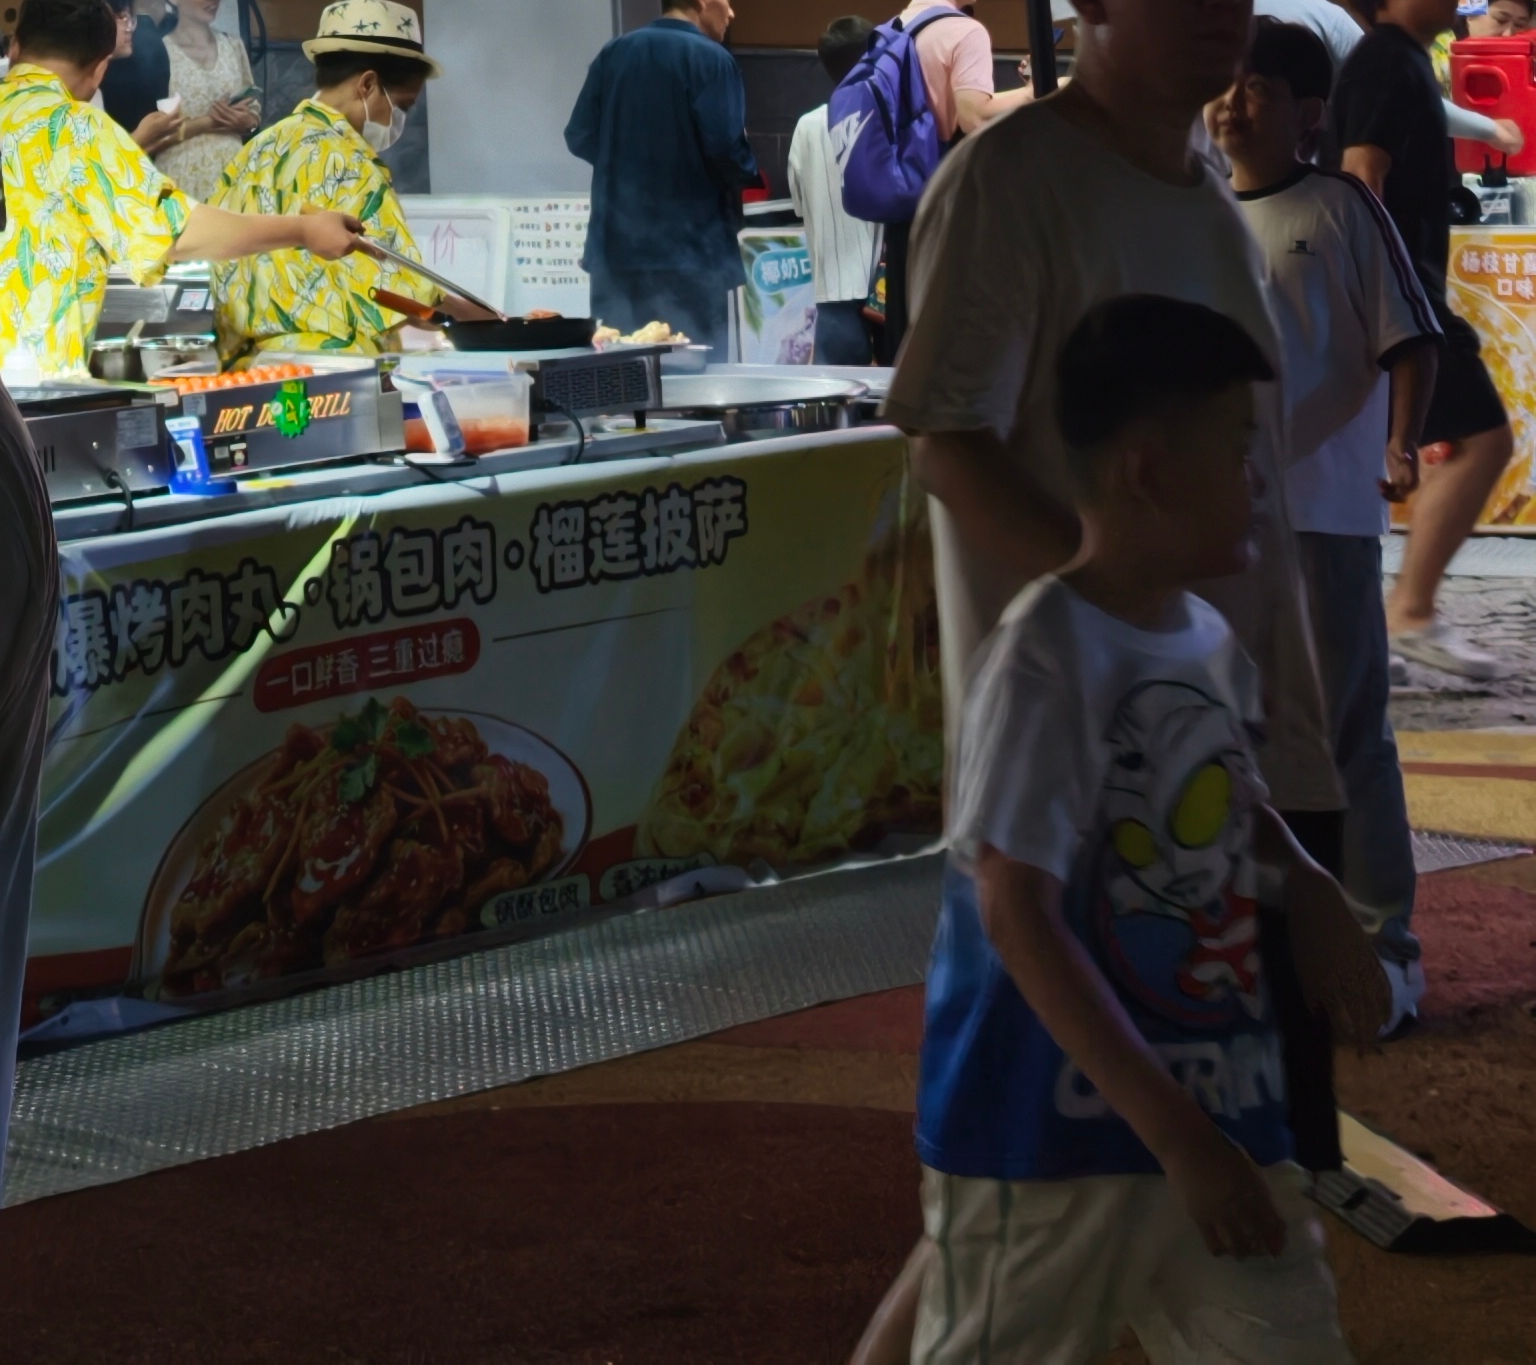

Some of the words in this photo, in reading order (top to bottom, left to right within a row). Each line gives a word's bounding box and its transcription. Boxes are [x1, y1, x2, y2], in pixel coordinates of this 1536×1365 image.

[214, 404, 253, 434] HOT
[266, 647, 359, 696] 一口鲜香
